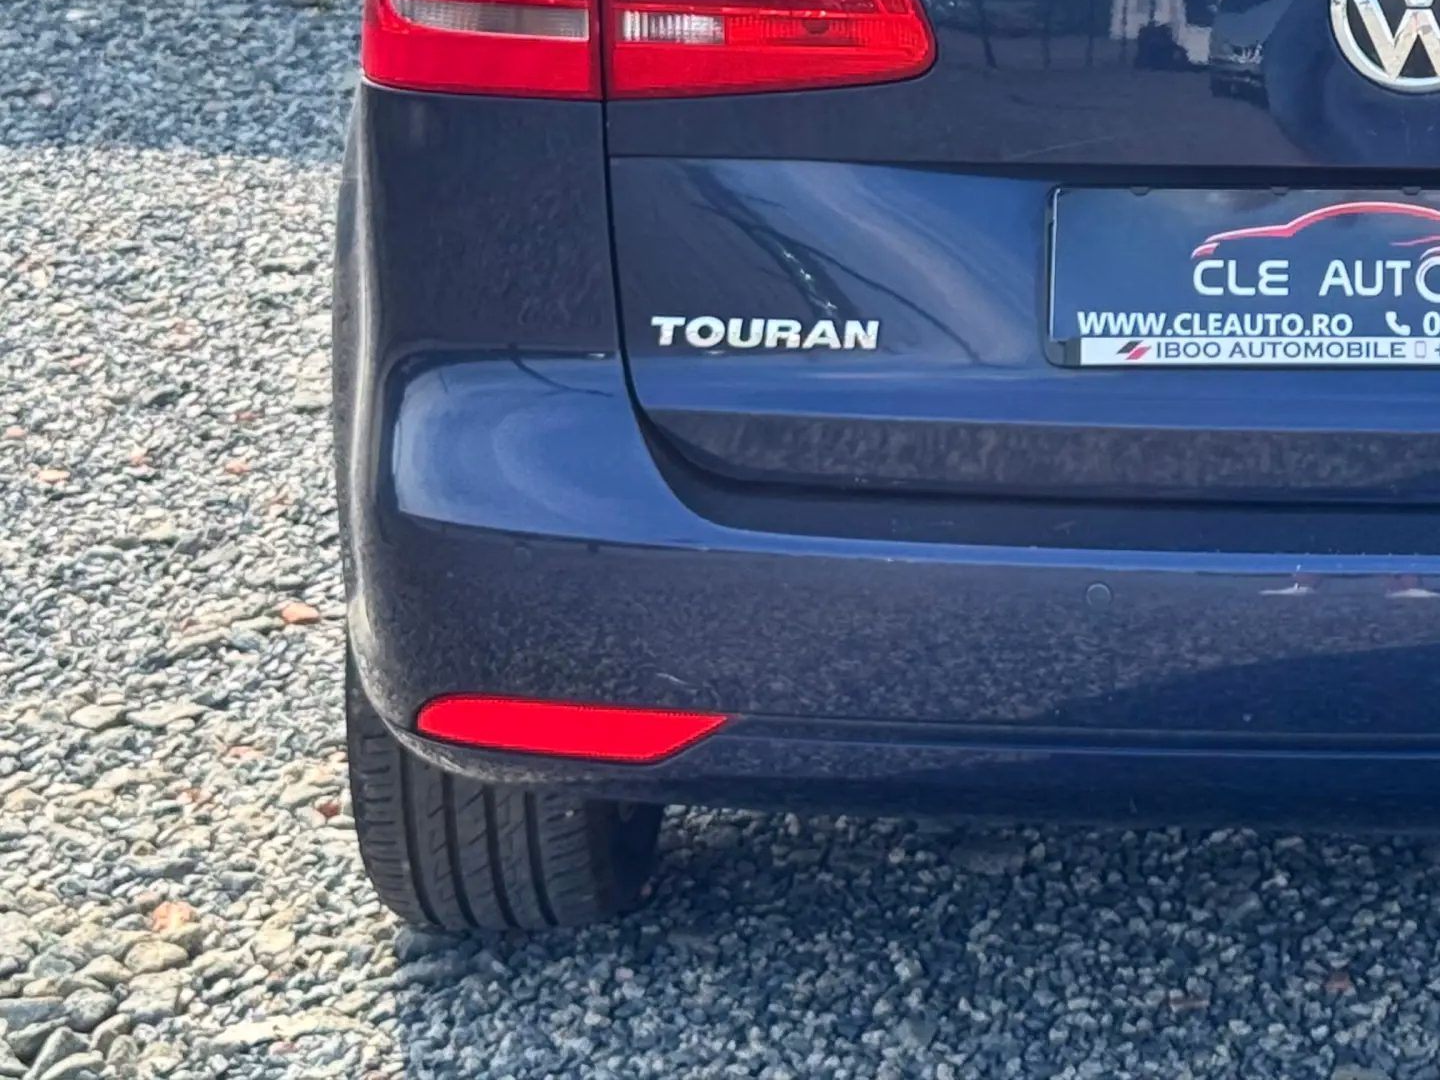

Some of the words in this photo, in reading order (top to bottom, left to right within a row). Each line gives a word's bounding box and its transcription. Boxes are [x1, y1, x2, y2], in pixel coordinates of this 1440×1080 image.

[1193, 259, 1289, 296] CLE
[651, 315, 880, 349] TOURAN
[1077, 311, 1354, 337] WWW.CLEAUTO.RO
[1156, 340, 1222, 360] IBOO
[1228, 340, 1406, 360] AUTOMOBILE
